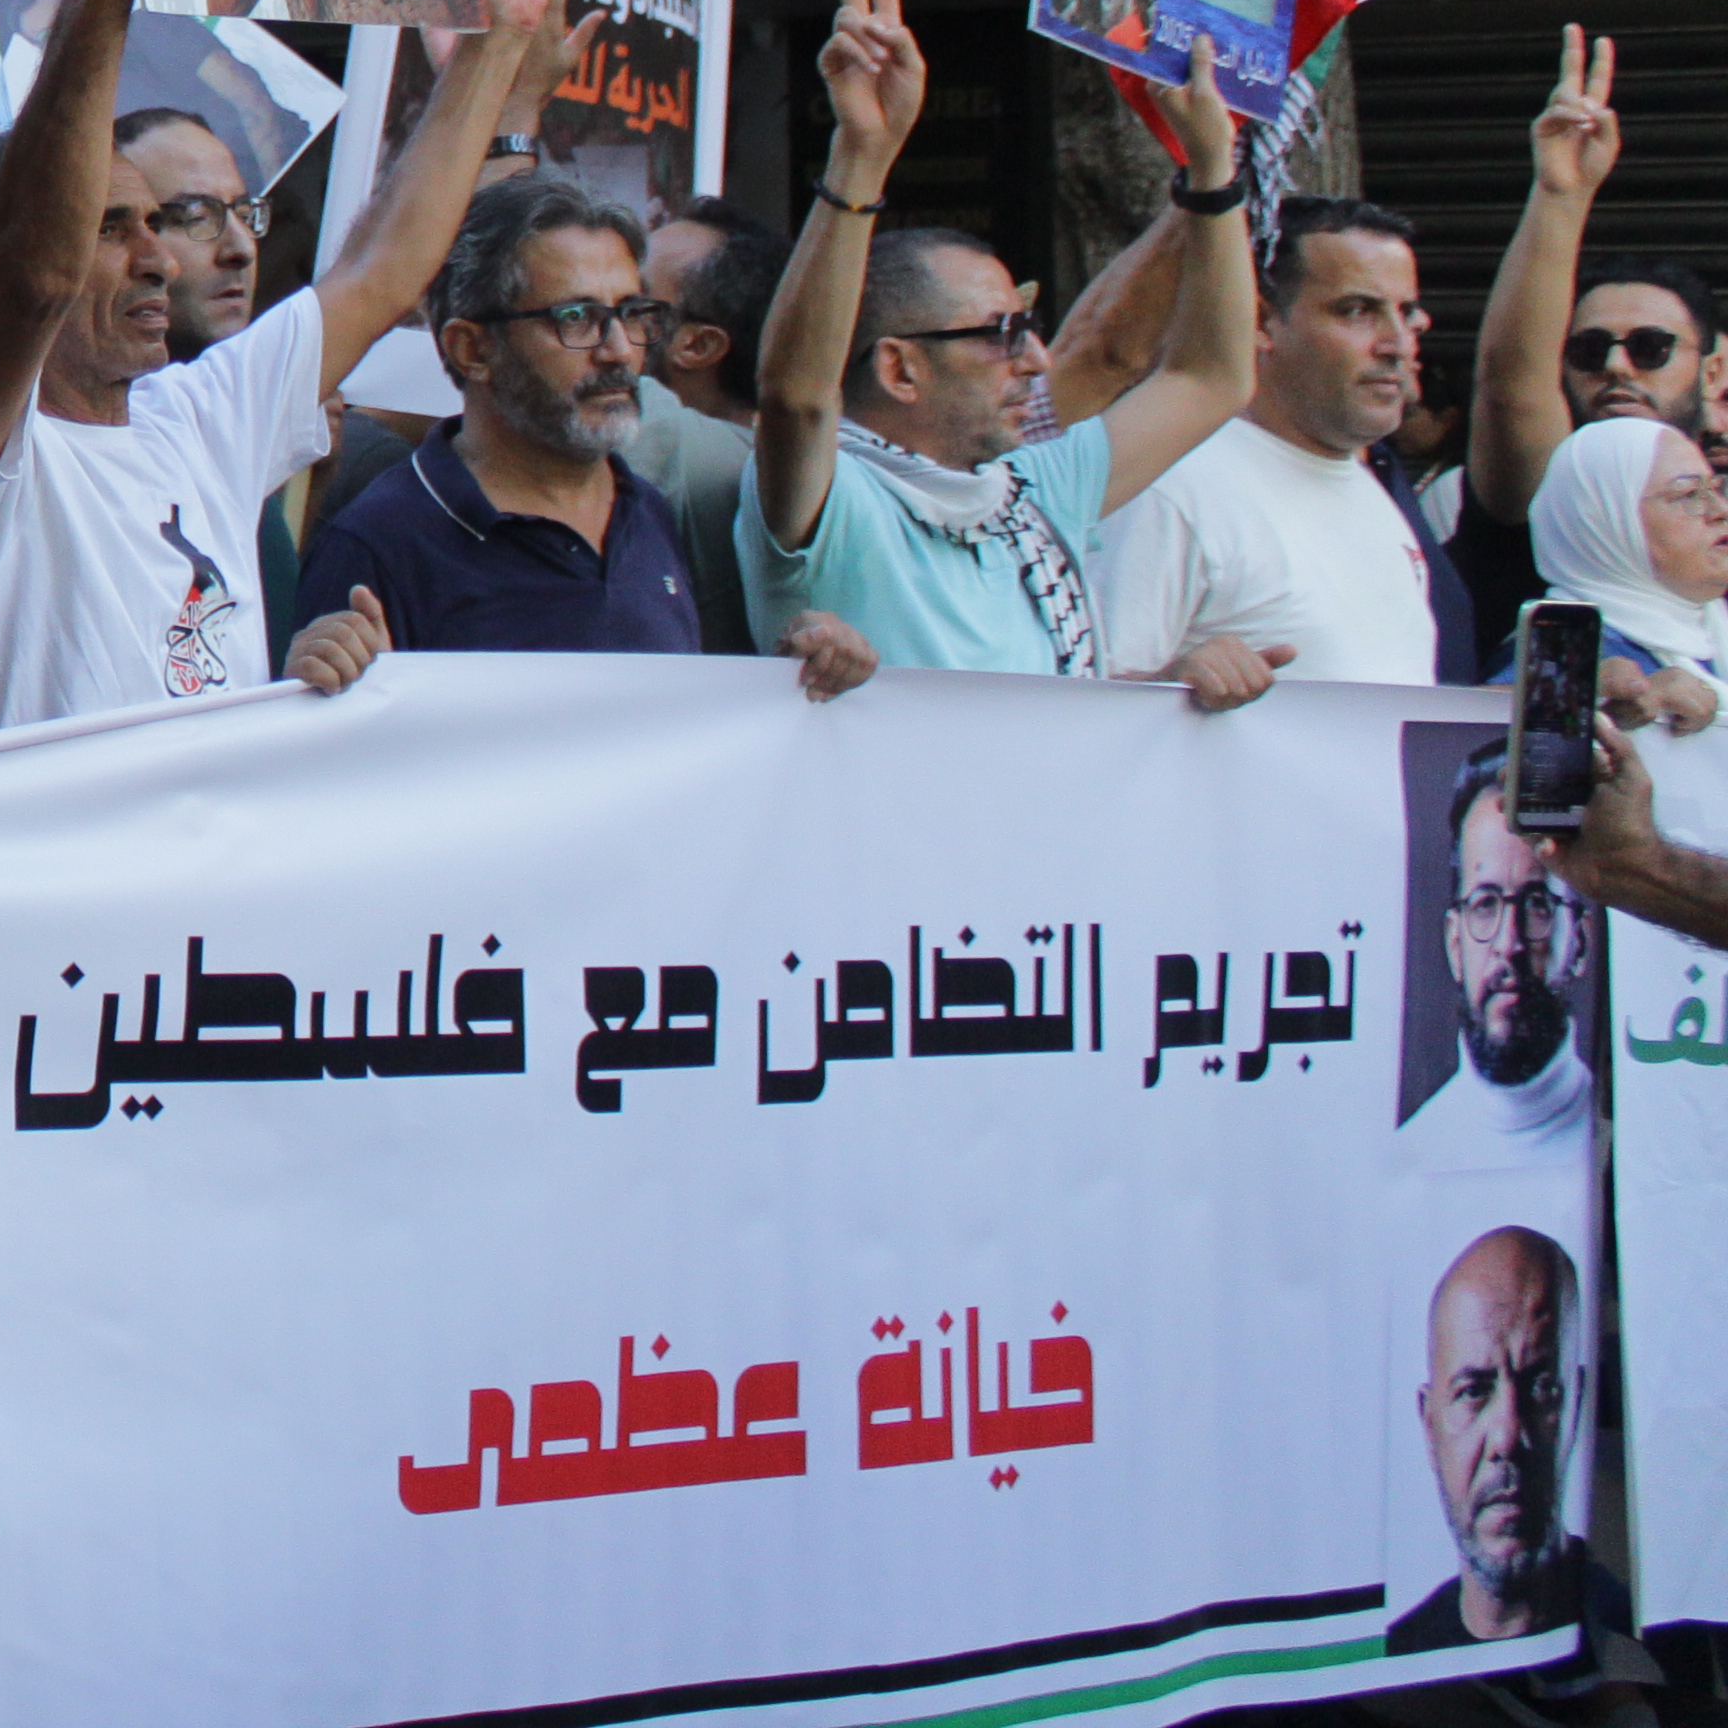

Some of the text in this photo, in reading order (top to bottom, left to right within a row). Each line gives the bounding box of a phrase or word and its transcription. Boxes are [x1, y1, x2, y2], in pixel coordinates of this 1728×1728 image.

[608, 43, 690, 134] الحرية
[14, 919, 1365, 1132] تجريم التضامن مع فلسطين
[398, 1297, 1095, 1517] خيانة عظمى
